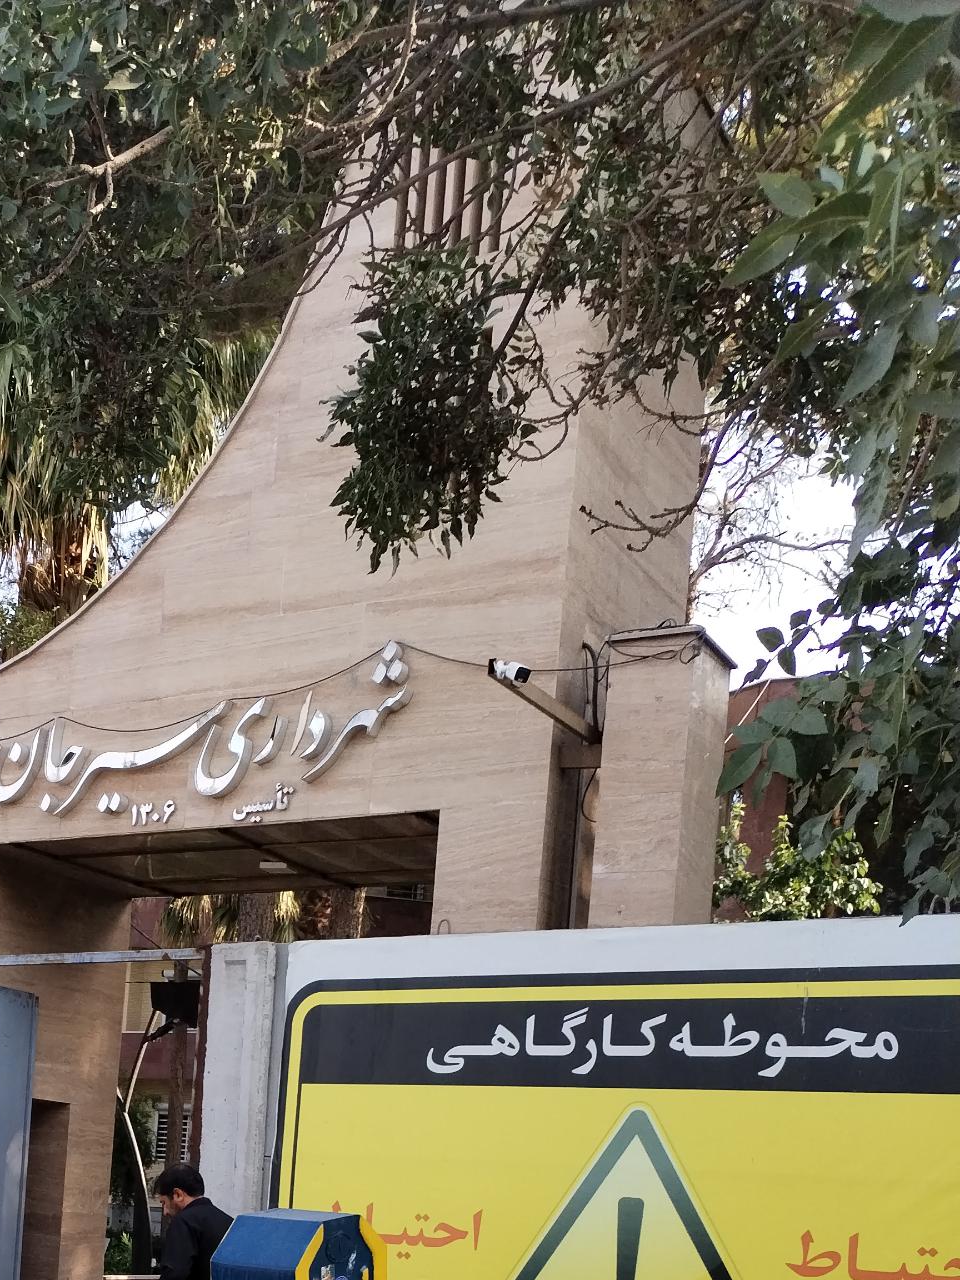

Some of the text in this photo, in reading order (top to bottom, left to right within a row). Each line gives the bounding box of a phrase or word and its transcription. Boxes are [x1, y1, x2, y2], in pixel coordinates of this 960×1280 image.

[194, 640, 414, 798] شهرداری
[130, 799, 177, 827] ۱۳۰۶
[426, 1006, 900, 1078] محوطه کارگاهی
[331, 1200, 483, 1260] احتیا
